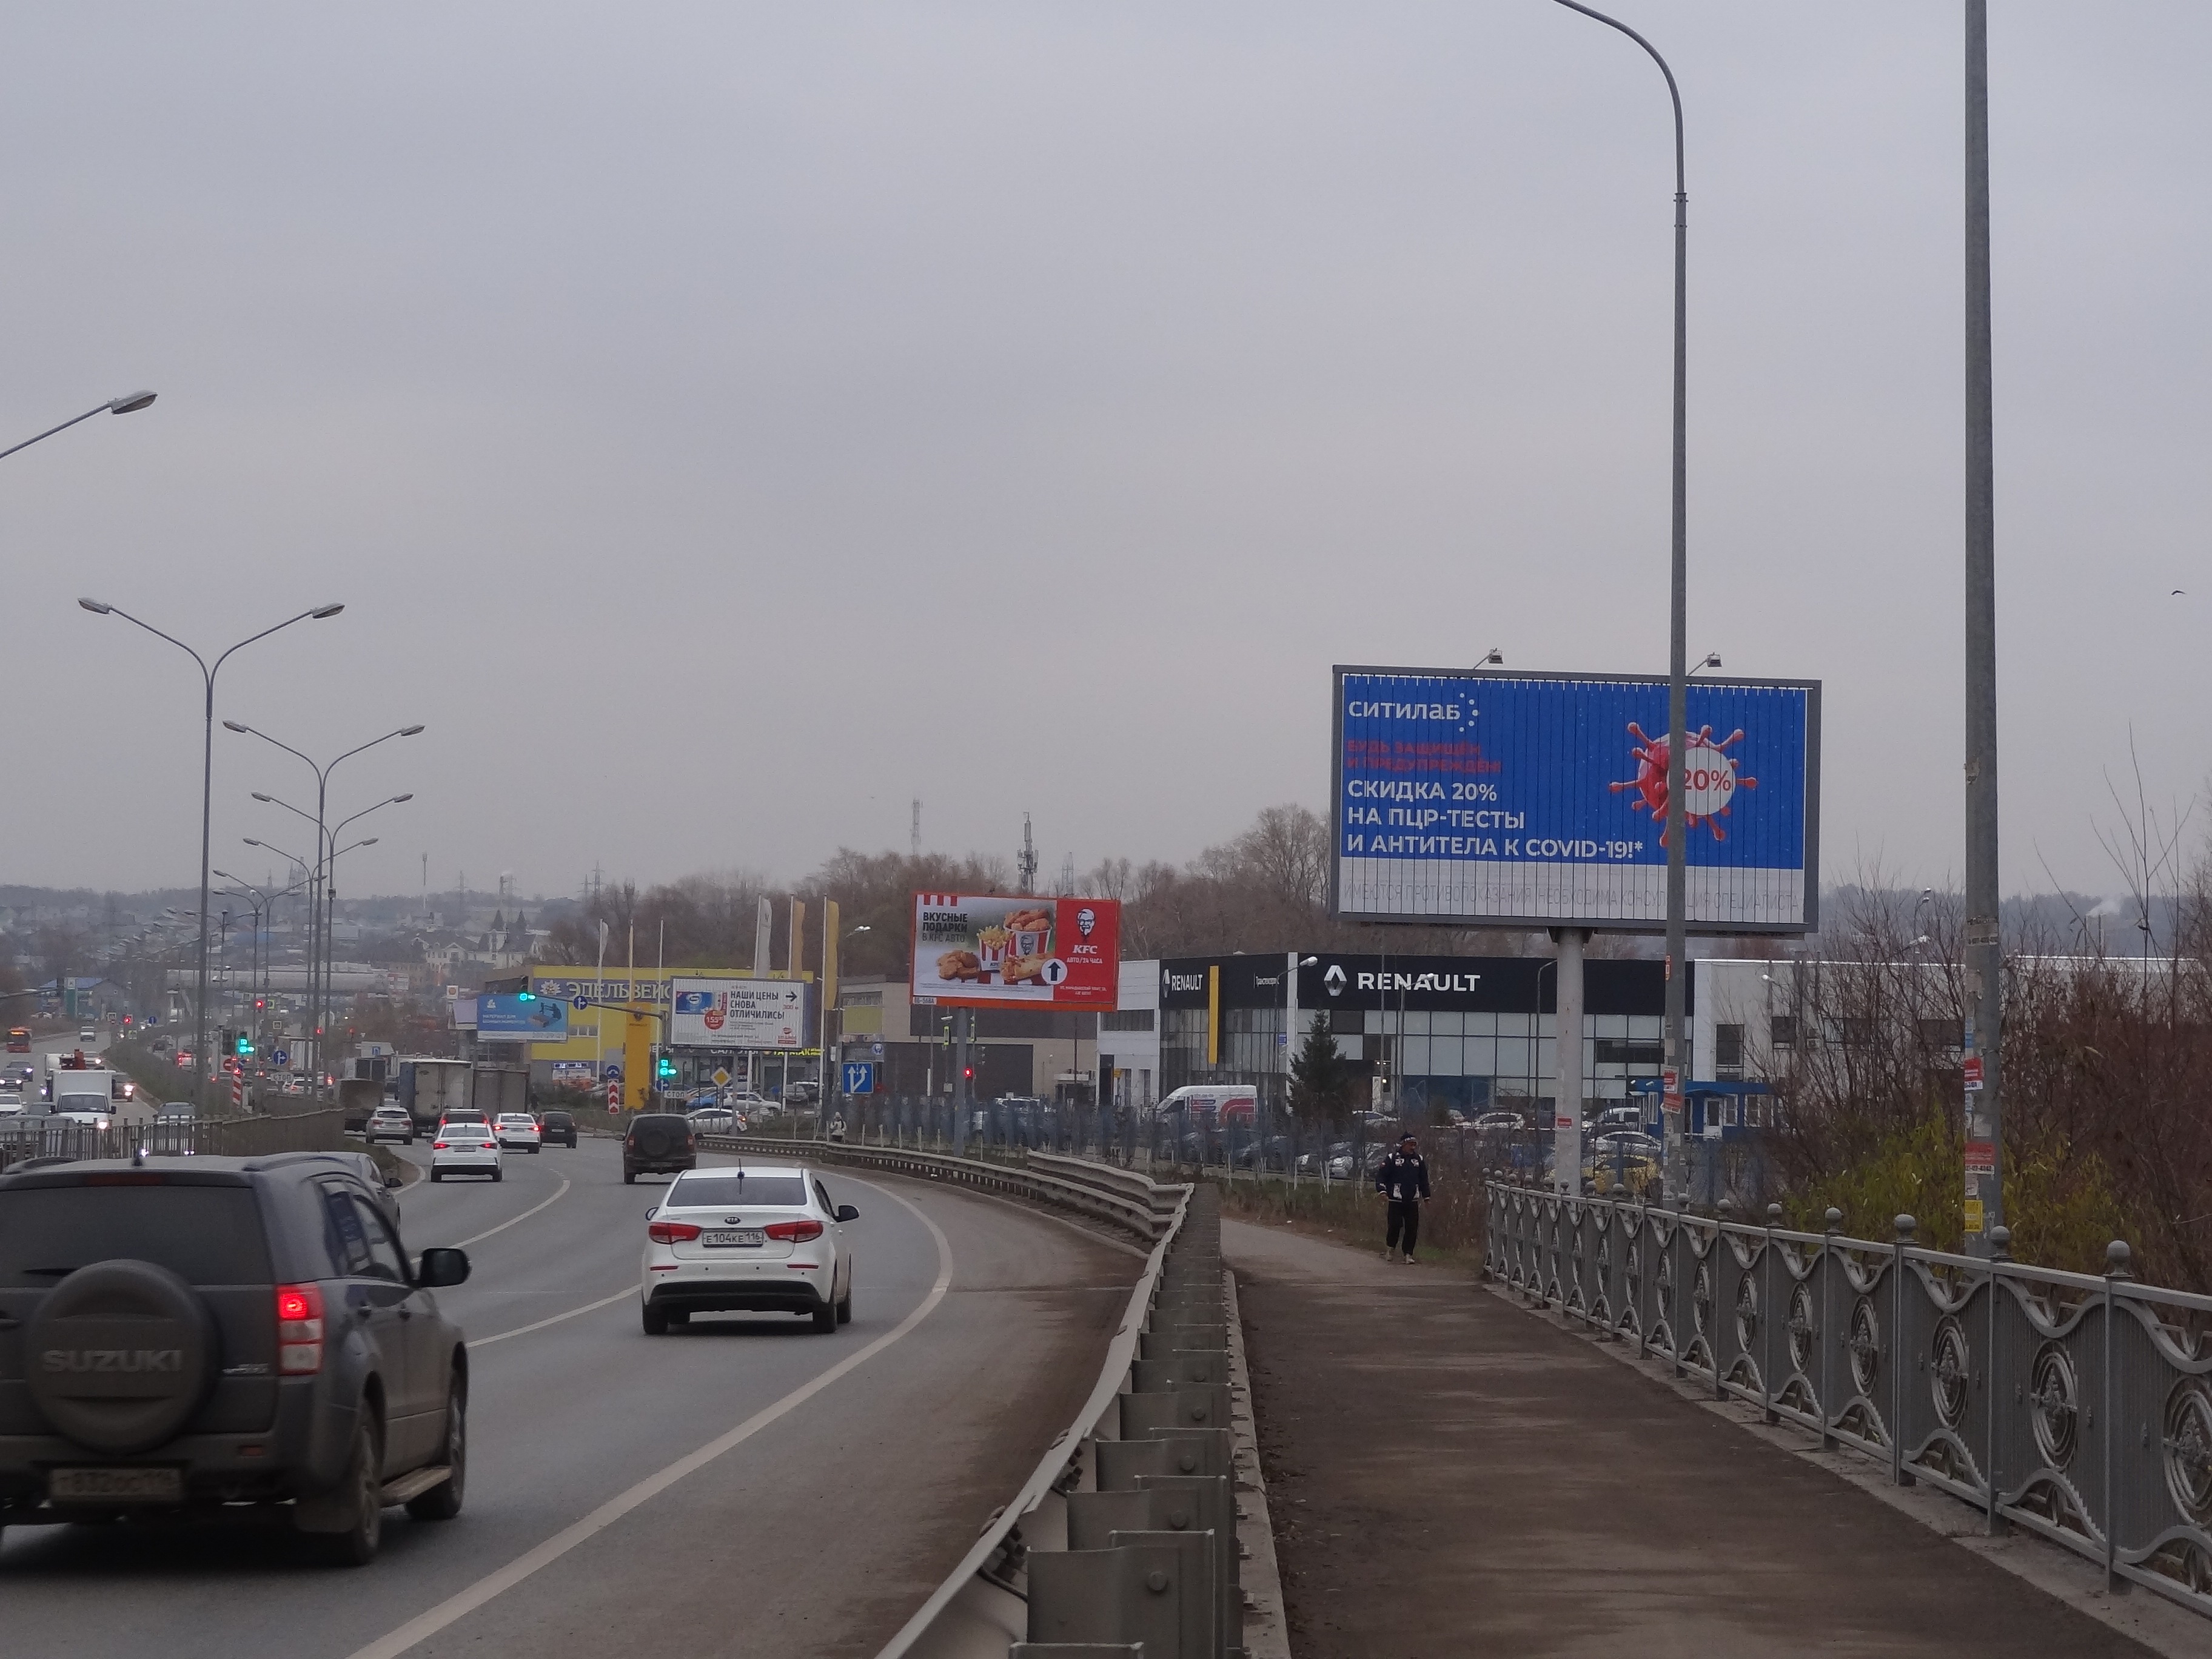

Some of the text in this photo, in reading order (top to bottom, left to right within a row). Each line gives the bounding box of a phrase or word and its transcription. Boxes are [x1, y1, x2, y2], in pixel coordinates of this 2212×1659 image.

[1347, 779, 1498, 802] СКИДКА 20%
[1348, 806, 1525, 830] НА ПЦР-ТЕСТЫ
[1347, 834, 1364, 852] И
[1370, 834, 1498, 856] АНТИТЕЛА
[1505, 838, 1520, 856] К
[1344, 884, 1402, 901] ИМЕЮТСЯ
[923, 912, 968, 922] ВКУСНЫЕ
[922, 922, 968, 933] ПОДАРКИ
[922, 933, 928, 941] В
[1072, 945, 1098, 954] KFC
[1171, 974, 1203, 991] RENAULT
[1358, 972, 1481, 992] RENAULT
[730, 1000, 756, 1009] СНОВА
[731, 991, 779, 1001] НАШИ ЦЕНЫ
[44, 1349, 183, 1373] SUZUKI
